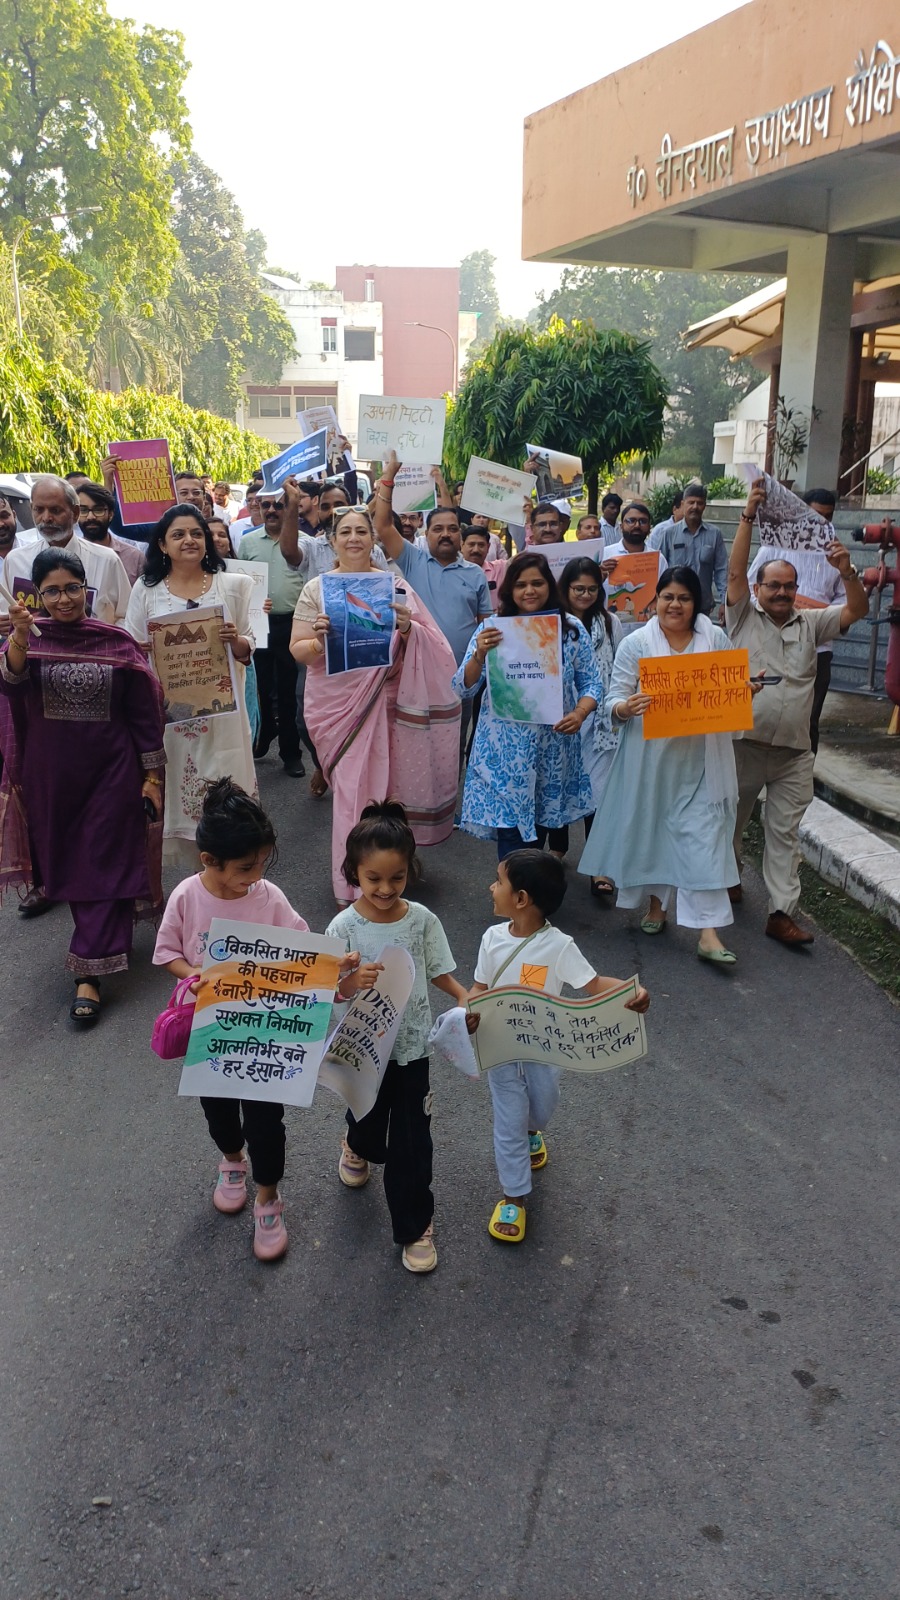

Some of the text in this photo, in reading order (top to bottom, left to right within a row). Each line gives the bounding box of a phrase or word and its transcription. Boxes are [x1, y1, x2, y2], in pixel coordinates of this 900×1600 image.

[655, 125, 736, 201] दीनदयाल
[744, 85, 834, 166] उपाध्याय
[845, 39, 900, 127] शैक्षि
[363, 404, 397, 422] अपनी
[156, 457, 168, 468] IN
[121, 478, 171, 491] DRIVEN BY
[517, 672, 526, 680] को
[710, 663, 721, 687] ही
[698, 689, 721, 709] भारत
[225, 935, 319, 968] विकसित भारत
[238, 960, 308, 985] की पहचान
[222, 980, 310, 1010] नारी सम्मान
[216, 1009, 313, 1036] सशक्त निर्माण
[571, 1022, 622, 1044] विकसित
[207, 1036, 307, 1064] आत्मनिर्भर बने
[223, 1058, 286, 1083] हर इंसान
